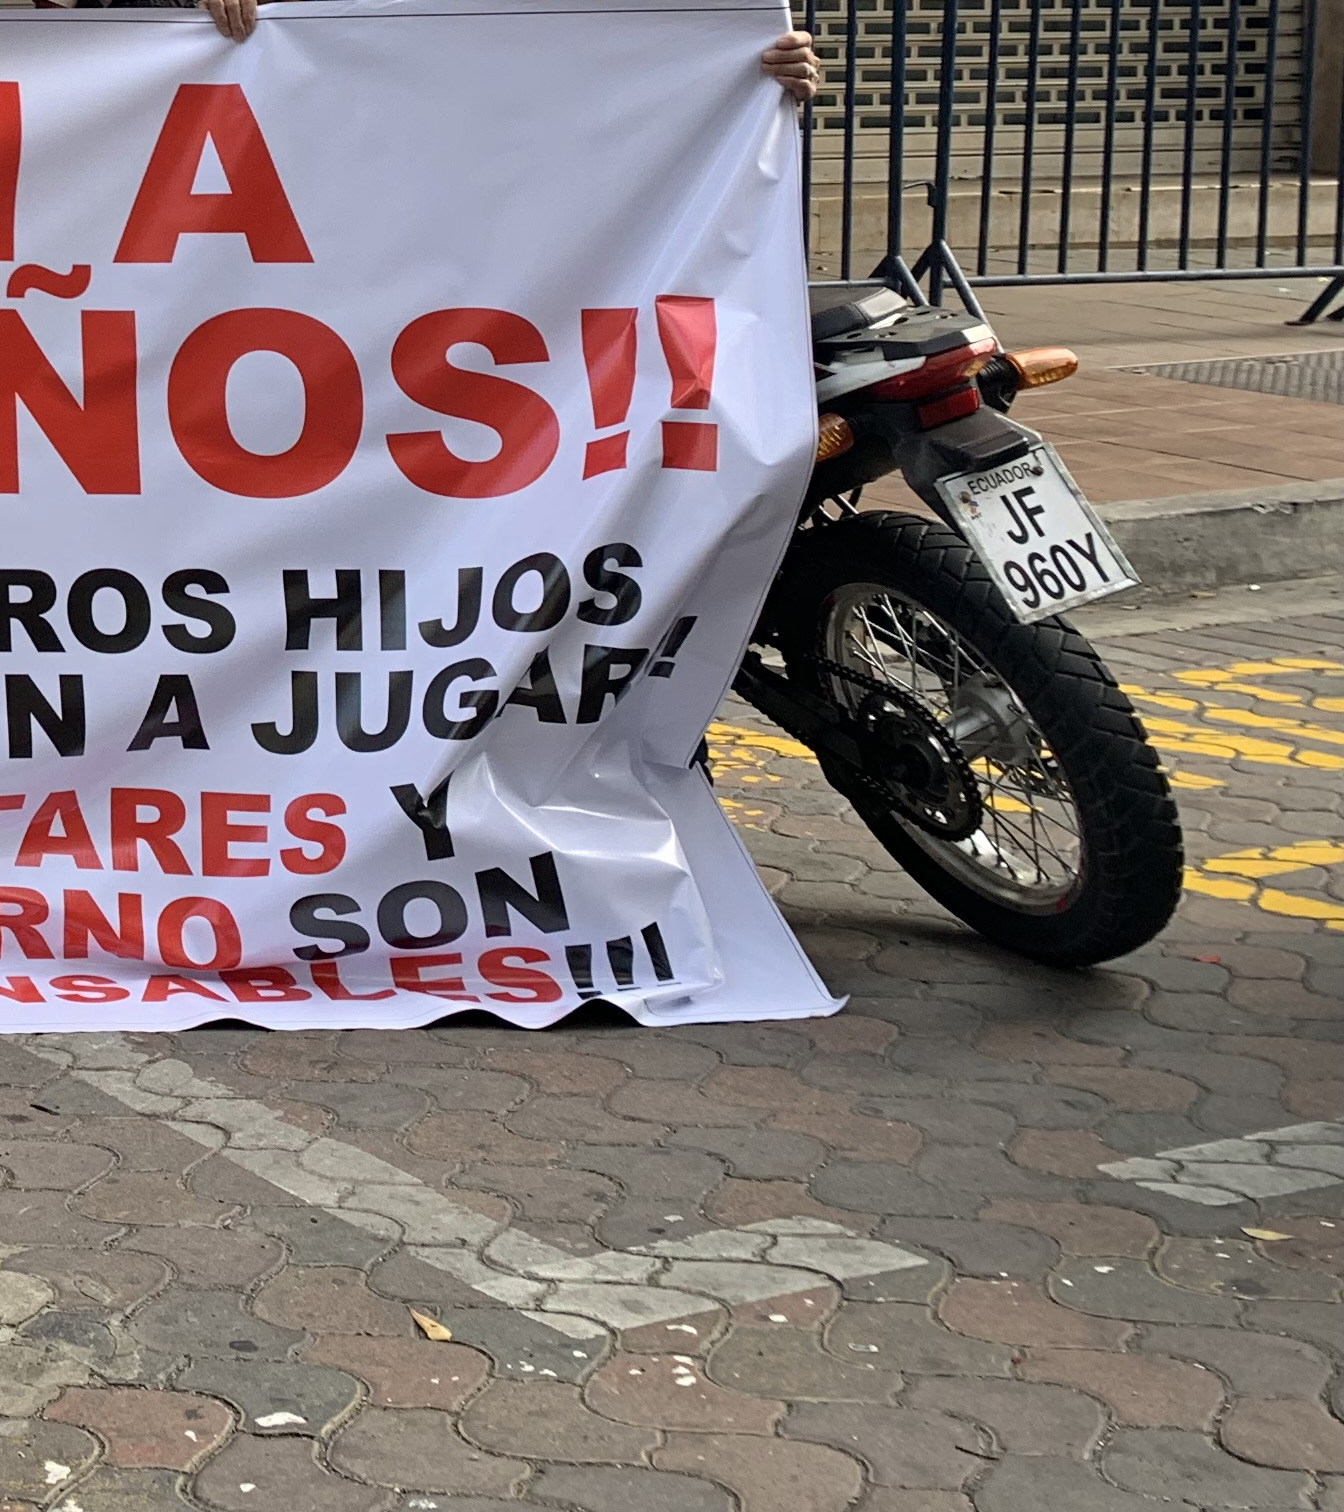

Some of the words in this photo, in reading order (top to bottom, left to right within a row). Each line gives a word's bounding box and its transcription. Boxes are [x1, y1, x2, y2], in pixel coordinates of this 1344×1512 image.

[112, 82, 314, 263] A
[967, 461, 1033, 495] ECUADOR
[1000, 486, 1045, 545] JF
[282, 542, 643, 651] HIJOS
[1003, 532, 1110, 609] 960Y
[126, 674, 210, 750] A
[390, 769, 458, 861] Y
[288, 851, 569, 962] SON
